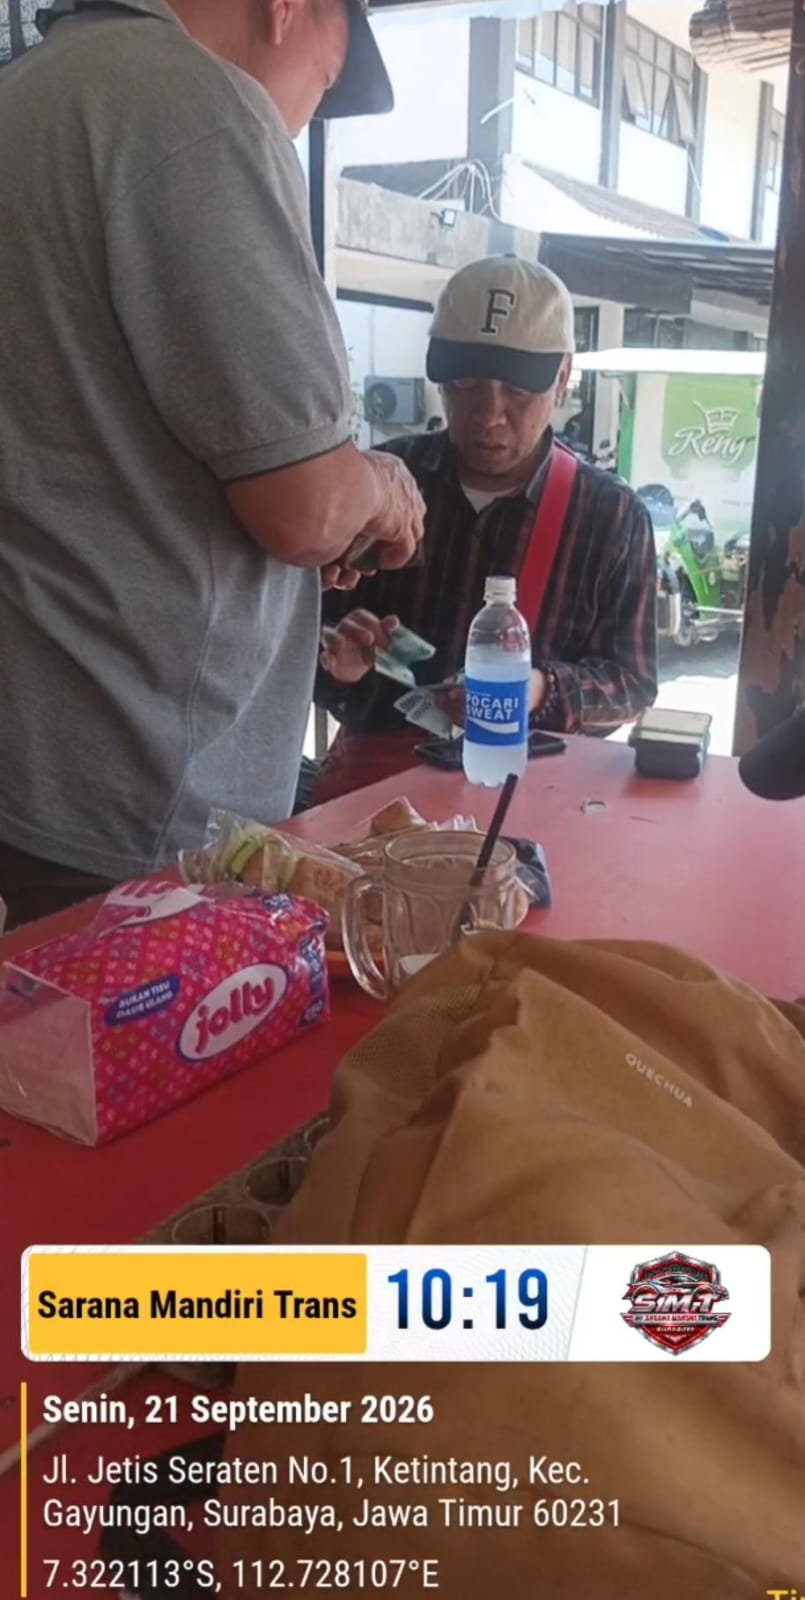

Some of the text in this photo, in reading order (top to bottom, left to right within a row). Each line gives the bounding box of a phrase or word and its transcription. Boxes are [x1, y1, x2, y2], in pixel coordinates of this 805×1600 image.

[480, 289, 515, 333] F
[668, 425, 748, 467] Reny
[194, 976, 275, 1054] jolly
[625, 1052, 693, 1109] QUECHUA
